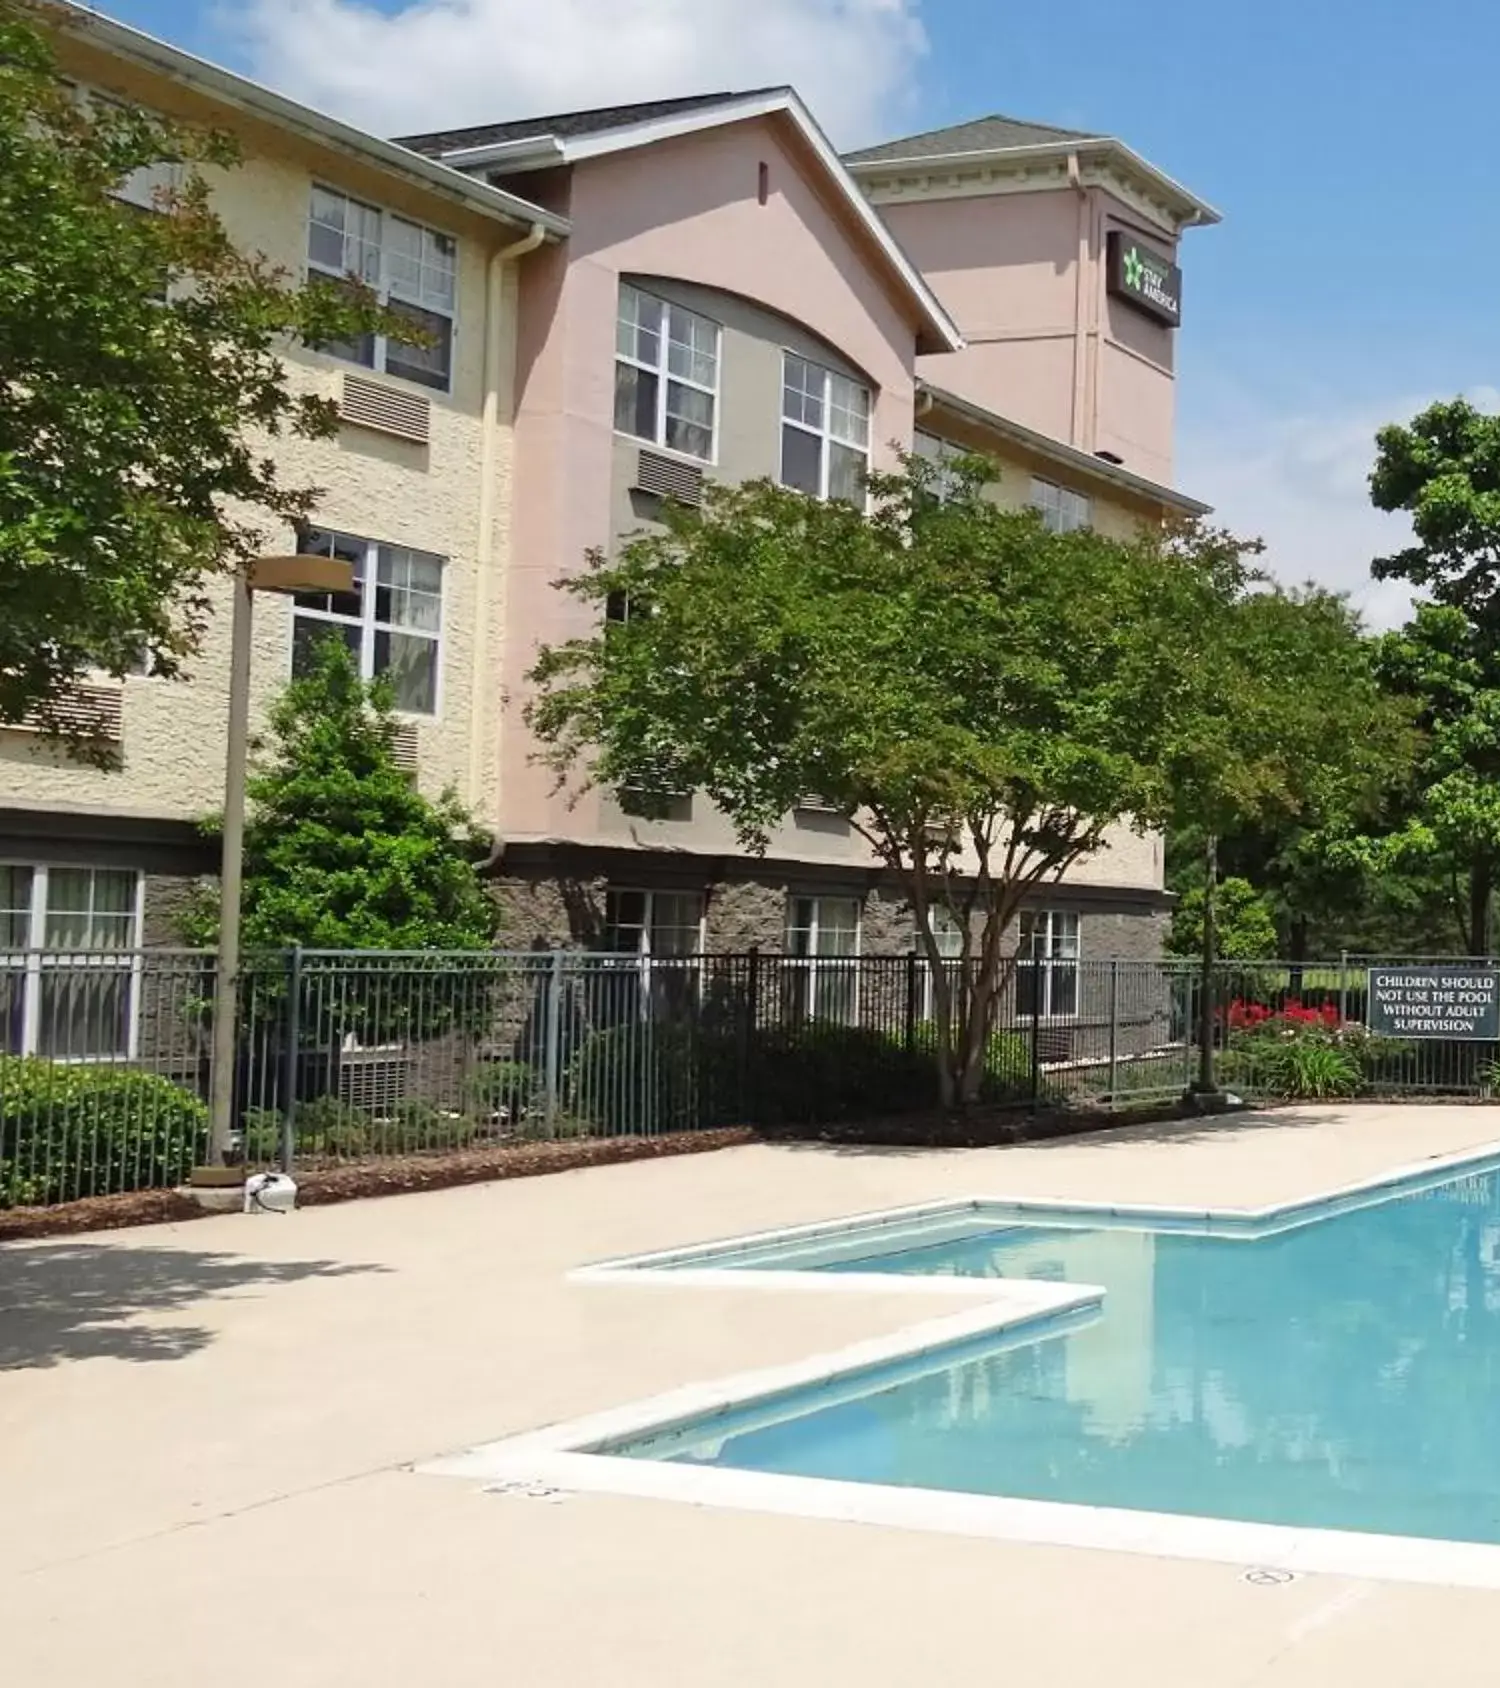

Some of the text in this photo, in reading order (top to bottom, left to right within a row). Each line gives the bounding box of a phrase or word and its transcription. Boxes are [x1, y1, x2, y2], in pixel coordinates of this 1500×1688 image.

[1143, 267, 1163, 289] STAY
[1143, 282, 1177, 313] AMERICA
[1376, 975, 1494, 989] CHILDREN SHOULD
[1376, 989, 1493, 1004] NOT USE THE POOL
[1383, 1004, 1486, 1017] WITHOUT ADULT
[1393, 1019, 1475, 1032] SUPERVISION
